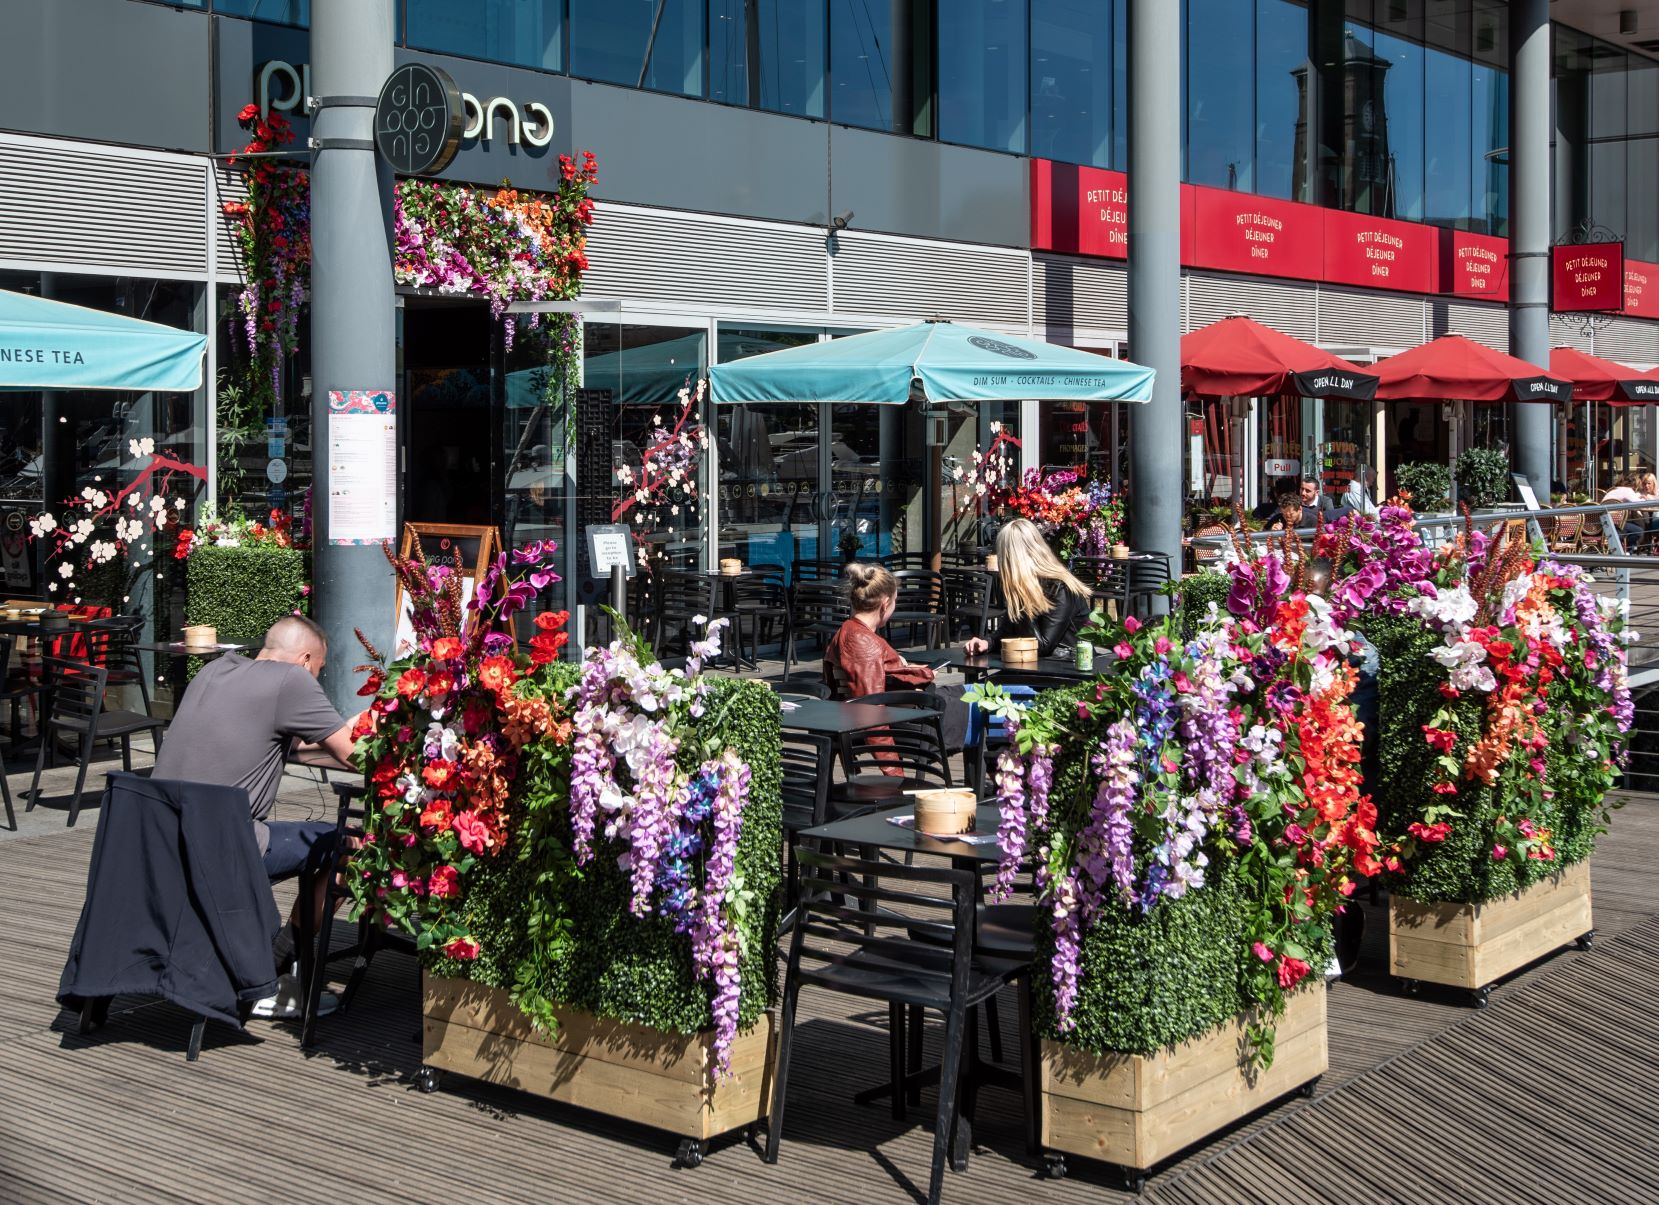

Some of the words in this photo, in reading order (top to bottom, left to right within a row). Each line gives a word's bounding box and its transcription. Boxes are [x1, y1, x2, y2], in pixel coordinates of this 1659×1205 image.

[1087, 189, 1110, 203] PETIT
[1236, 213, 1252, 225] PETIT
[1253, 212, 1283, 232] DÉJEUNER
[1245, 227, 1275, 243] DÉJEUNER
[1357, 231, 1373, 243] PETIT
[1374, 229, 1403, 249] DÉJEUNER
[1251, 245, 1269, 259] DÎNER
[1366, 246, 1395, 261] DÉJEUNER
[1458, 247, 1472, 258] PETIT
[1472, 245, 1498, 263] DÉJEUNER
[1372, 263, 1389, 277] DÎNER
[1466, 260, 1491, 274] DÉJEUNER
[1565, 258, 1580, 271] PETIT
[1581, 255, 1608, 268] DÉJEUNER
[1471, 277, 1486, 289] DÎNER
[1575, 271, 1601, 283] DÉJEUNER
[1581, 286, 1597, 297] DÎNER
[52, 350, 85, 365] TEA
[973, 377, 988, 386] DIM
[991, 376, 1007, 385] SUM
[1017, 376, 1055, 385] COCKTAILS
[1064, 377, 1092, 387] CHINESE
[1094, 378, 1106, 387] TEA
[1313, 376, 1329, 389] OPEN
[1340, 378, 1354, 390] DAY
[1530, 382, 1544, 392] OPEN
[1635, 385, 1647, 394] OPEN
[1274, 463, 1291, 472] Pull
